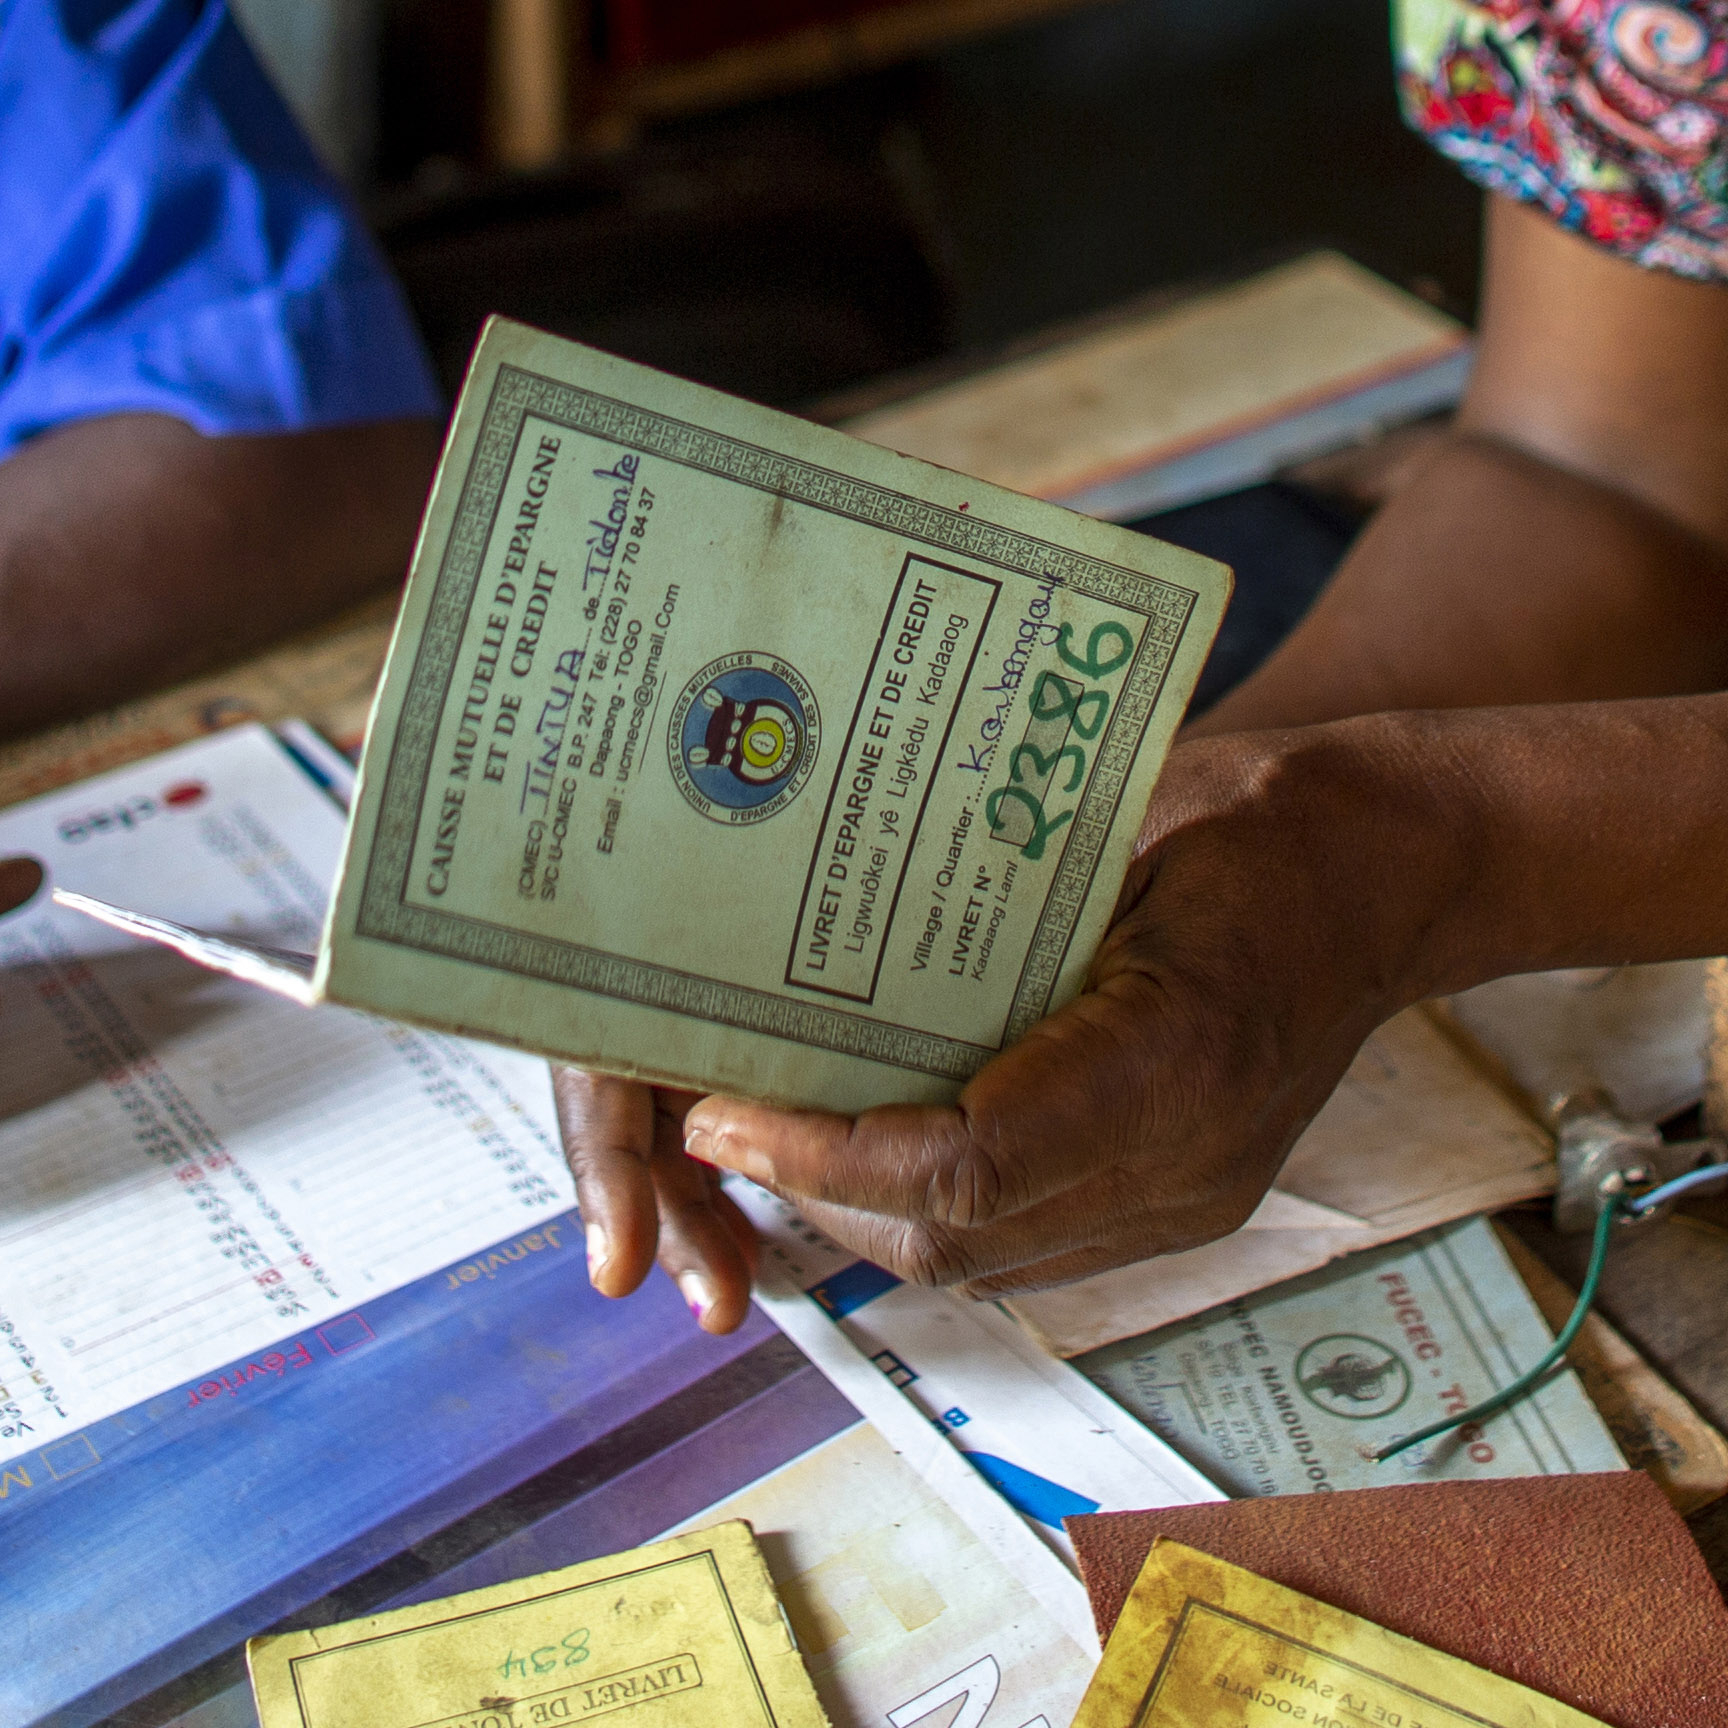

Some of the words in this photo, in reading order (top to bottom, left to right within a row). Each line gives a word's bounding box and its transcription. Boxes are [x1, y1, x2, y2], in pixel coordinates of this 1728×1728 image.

[638, 486, 654, 510] 37
[630, 516, 647, 537] 84
[621, 542, 639, 563] 70
[614, 568, 630, 593] 27
[510, 561, 557, 677] CREDIT
[600, 597, 626, 644] (228)
[893, 578, 936, 664] CREDIT
[426, 788, 464, 897] CAISSE
[449, 614, 508, 780] MUTUELLE
[494, 435, 560, 605] D'EPARGNE
[686, 653, 752, 694] MUTUELLES
[770, 660, 808, 700] SAVANES
[916, 613, 968, 705] Kadaaog
[589, 695, 624, 777] Dapaong
[614, 619, 641, 676] TOGO
[880, 669, 906, 703] DE
[493, 694, 521, 735] DE
[577, 692, 596, 727] 247
[596, 798, 621, 853] Email
[616, 584, 679, 782] ucmecs@gmail.Com
[669, 694, 691, 750] CAISSES
[804, 702, 817, 726] DES
[868, 706, 893, 738] ET
[483, 743, 507, 783] ET
[518, 820, 556, 899] (CMEC)
[583, 597, 599, 620] de
[567, 734, 587, 768] B.P.
[673, 754, 686, 780] DES
[797, 732, 816, 775] CREDIT
[886, 717, 928, 797] Ligkêdu
[682, 780, 712, 814] UNION
[787, 775, 802, 793] ET
[948, 895, 982, 975] LIVRET
[973, 865, 991, 891] N°
[986, 621, 1134, 861] 2386
[547, 777, 576, 862] U-CMEC
[729, 791, 789, 822] D'EPARGNE
[879, 810, 898, 837] yê
[540, 866, 558, 900] S/C
[844, 846, 888, 953] Ligwuôkei
[910, 906, 942, 970] Village
[936, 806, 973, 887] Quartier
[806, 884, 841, 970] LIVRET
[971, 906, 1005, 981] Kadaaog
[445, 1223, 559, 1291] Janvier
[184, 1339, 313, 1410] Février
[582, 1664, 686, 1711] LIVRET
[530, 1697, 572, 1723] DE
